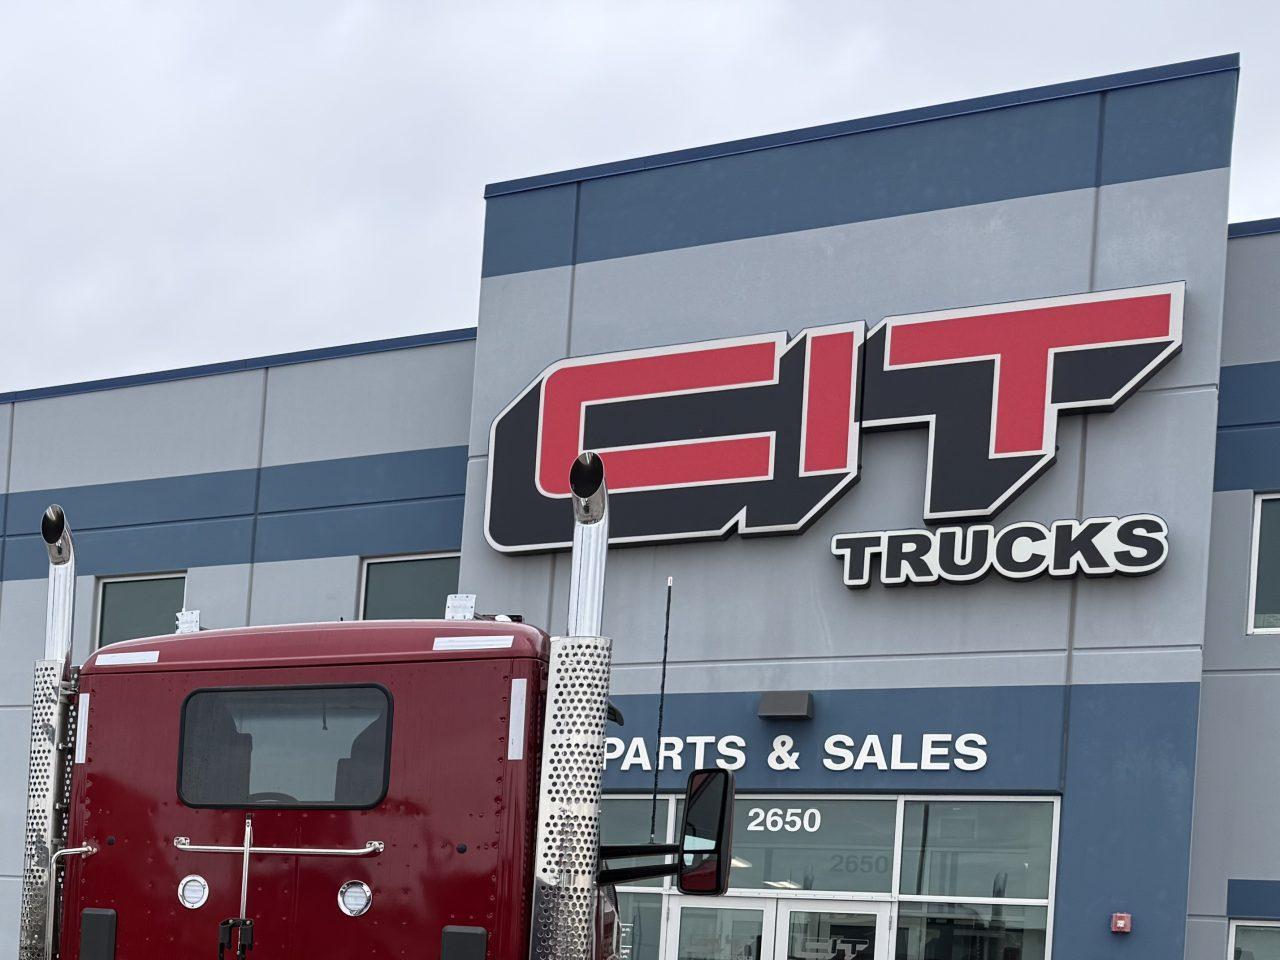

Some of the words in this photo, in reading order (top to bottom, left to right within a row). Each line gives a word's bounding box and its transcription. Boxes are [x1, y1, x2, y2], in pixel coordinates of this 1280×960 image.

[486, 281, 1185, 552] CIT
[832, 515, 1168, 586] TRUCKS
[604, 735, 746, 771] PARTS
[767, 734, 800, 770] &
[823, 733, 988, 771] SALES
[747, 808, 820, 832] 2650
